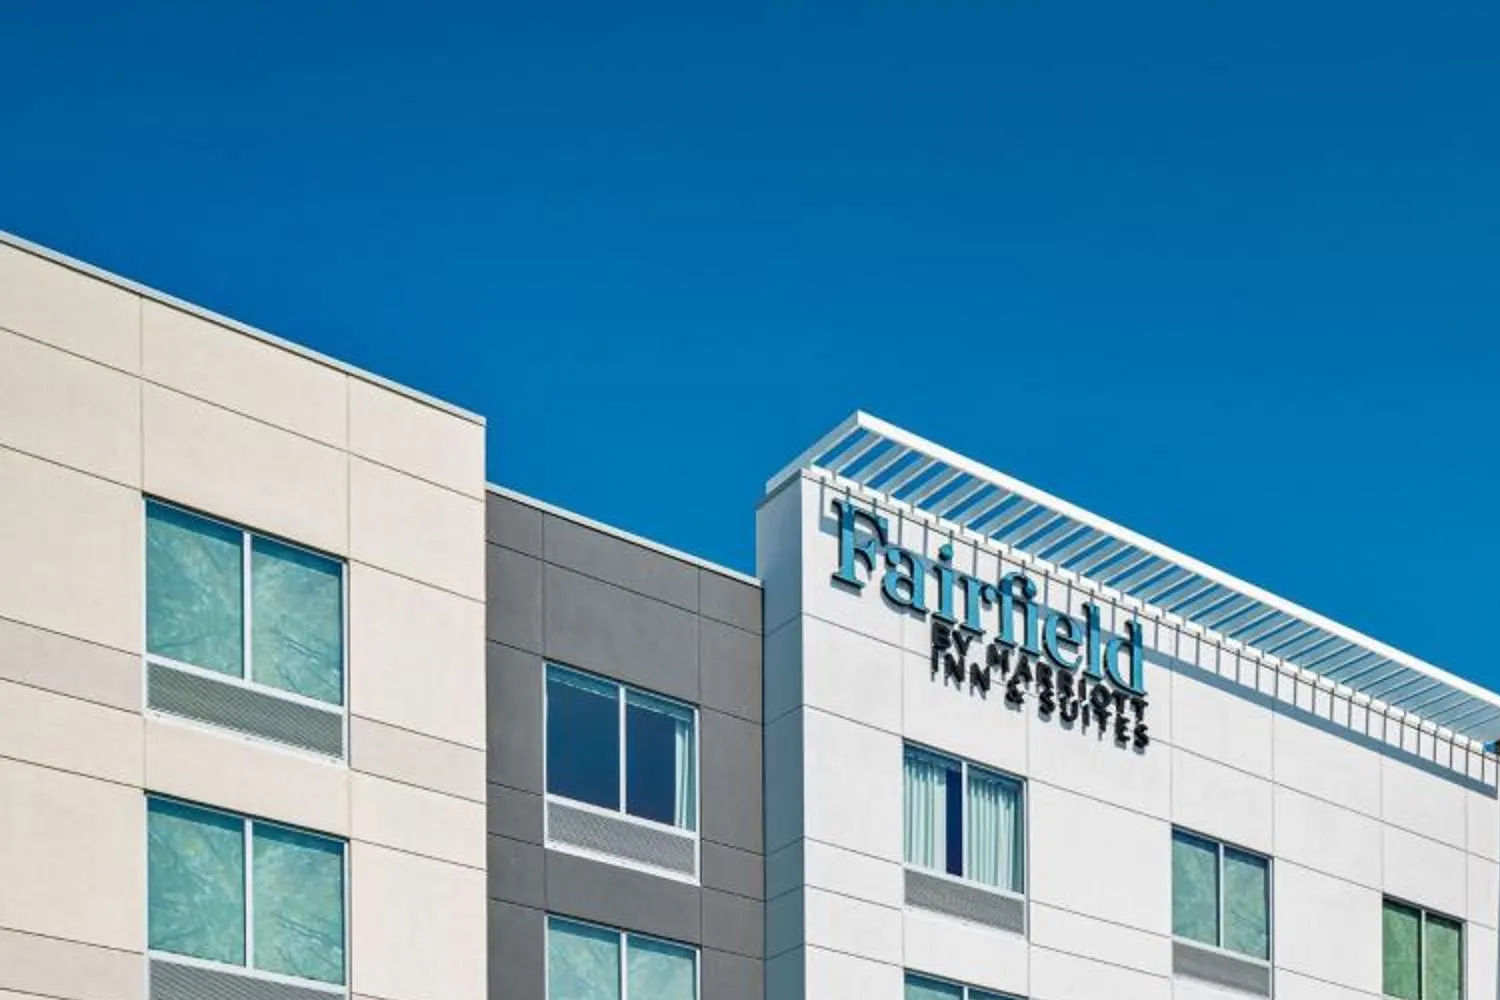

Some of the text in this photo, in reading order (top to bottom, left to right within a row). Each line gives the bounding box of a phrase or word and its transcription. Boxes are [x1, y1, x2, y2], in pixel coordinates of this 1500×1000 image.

[830, 498, 1147, 697] Fairfield
[931, 621, 1149, 722] BY MARRIOTT
[931, 650, 1149, 748] INN & SUITES
